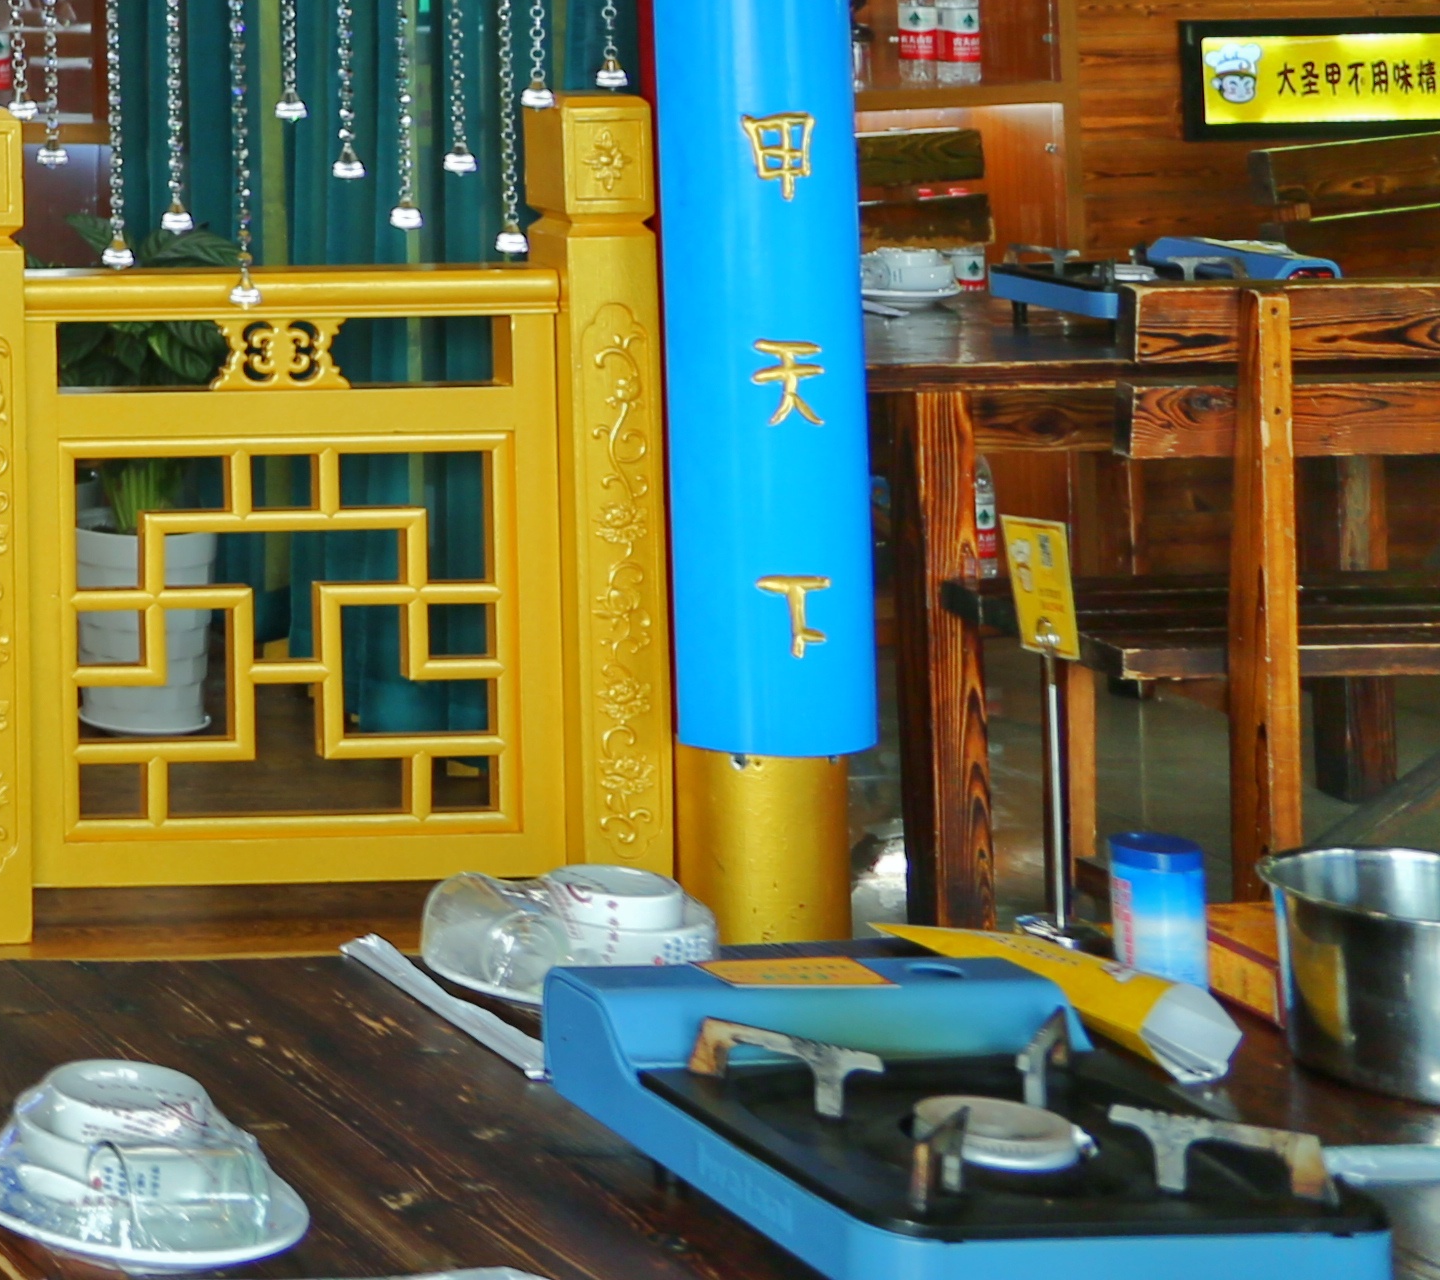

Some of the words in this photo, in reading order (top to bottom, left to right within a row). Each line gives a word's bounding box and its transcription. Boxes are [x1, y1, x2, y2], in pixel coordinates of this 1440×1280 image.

[1276, 59, 1437, 97] 大圣甲不用味精
